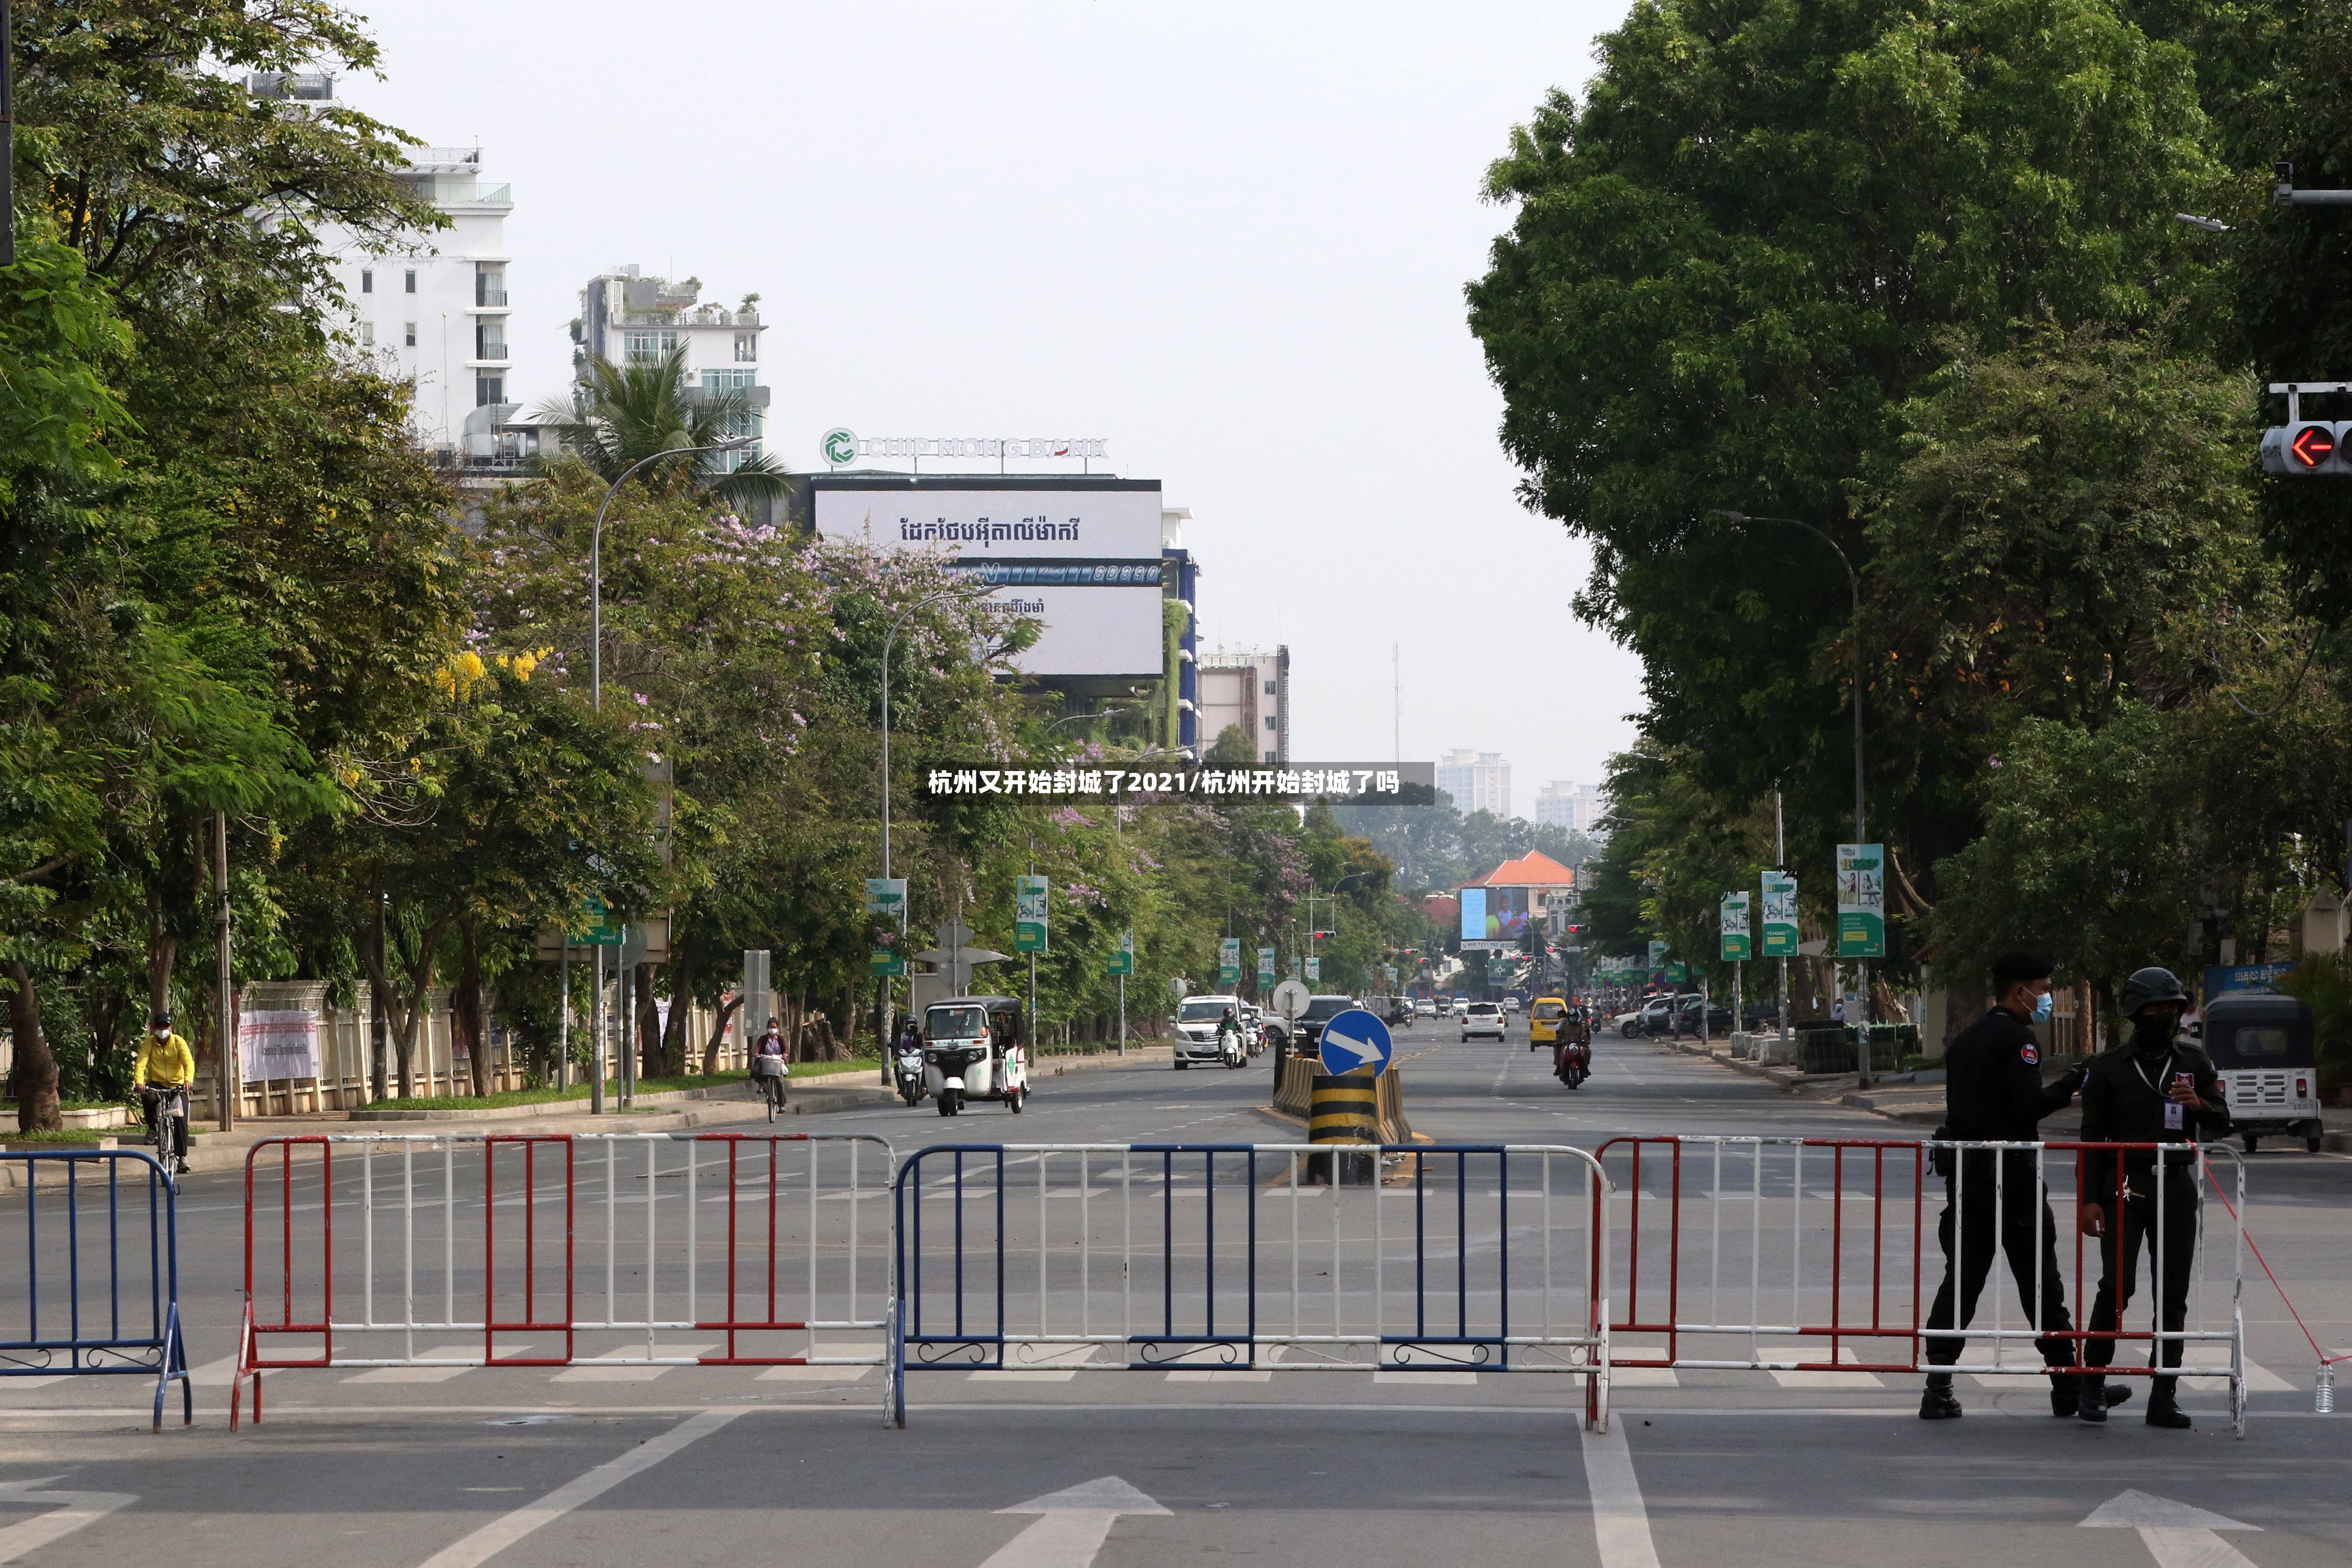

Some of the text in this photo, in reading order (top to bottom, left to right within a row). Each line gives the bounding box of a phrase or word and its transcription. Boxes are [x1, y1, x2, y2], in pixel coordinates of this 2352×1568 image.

[866, 437, 1109, 458] CHIP MONG BANK
[1094, 565, 1161, 580] SD390
